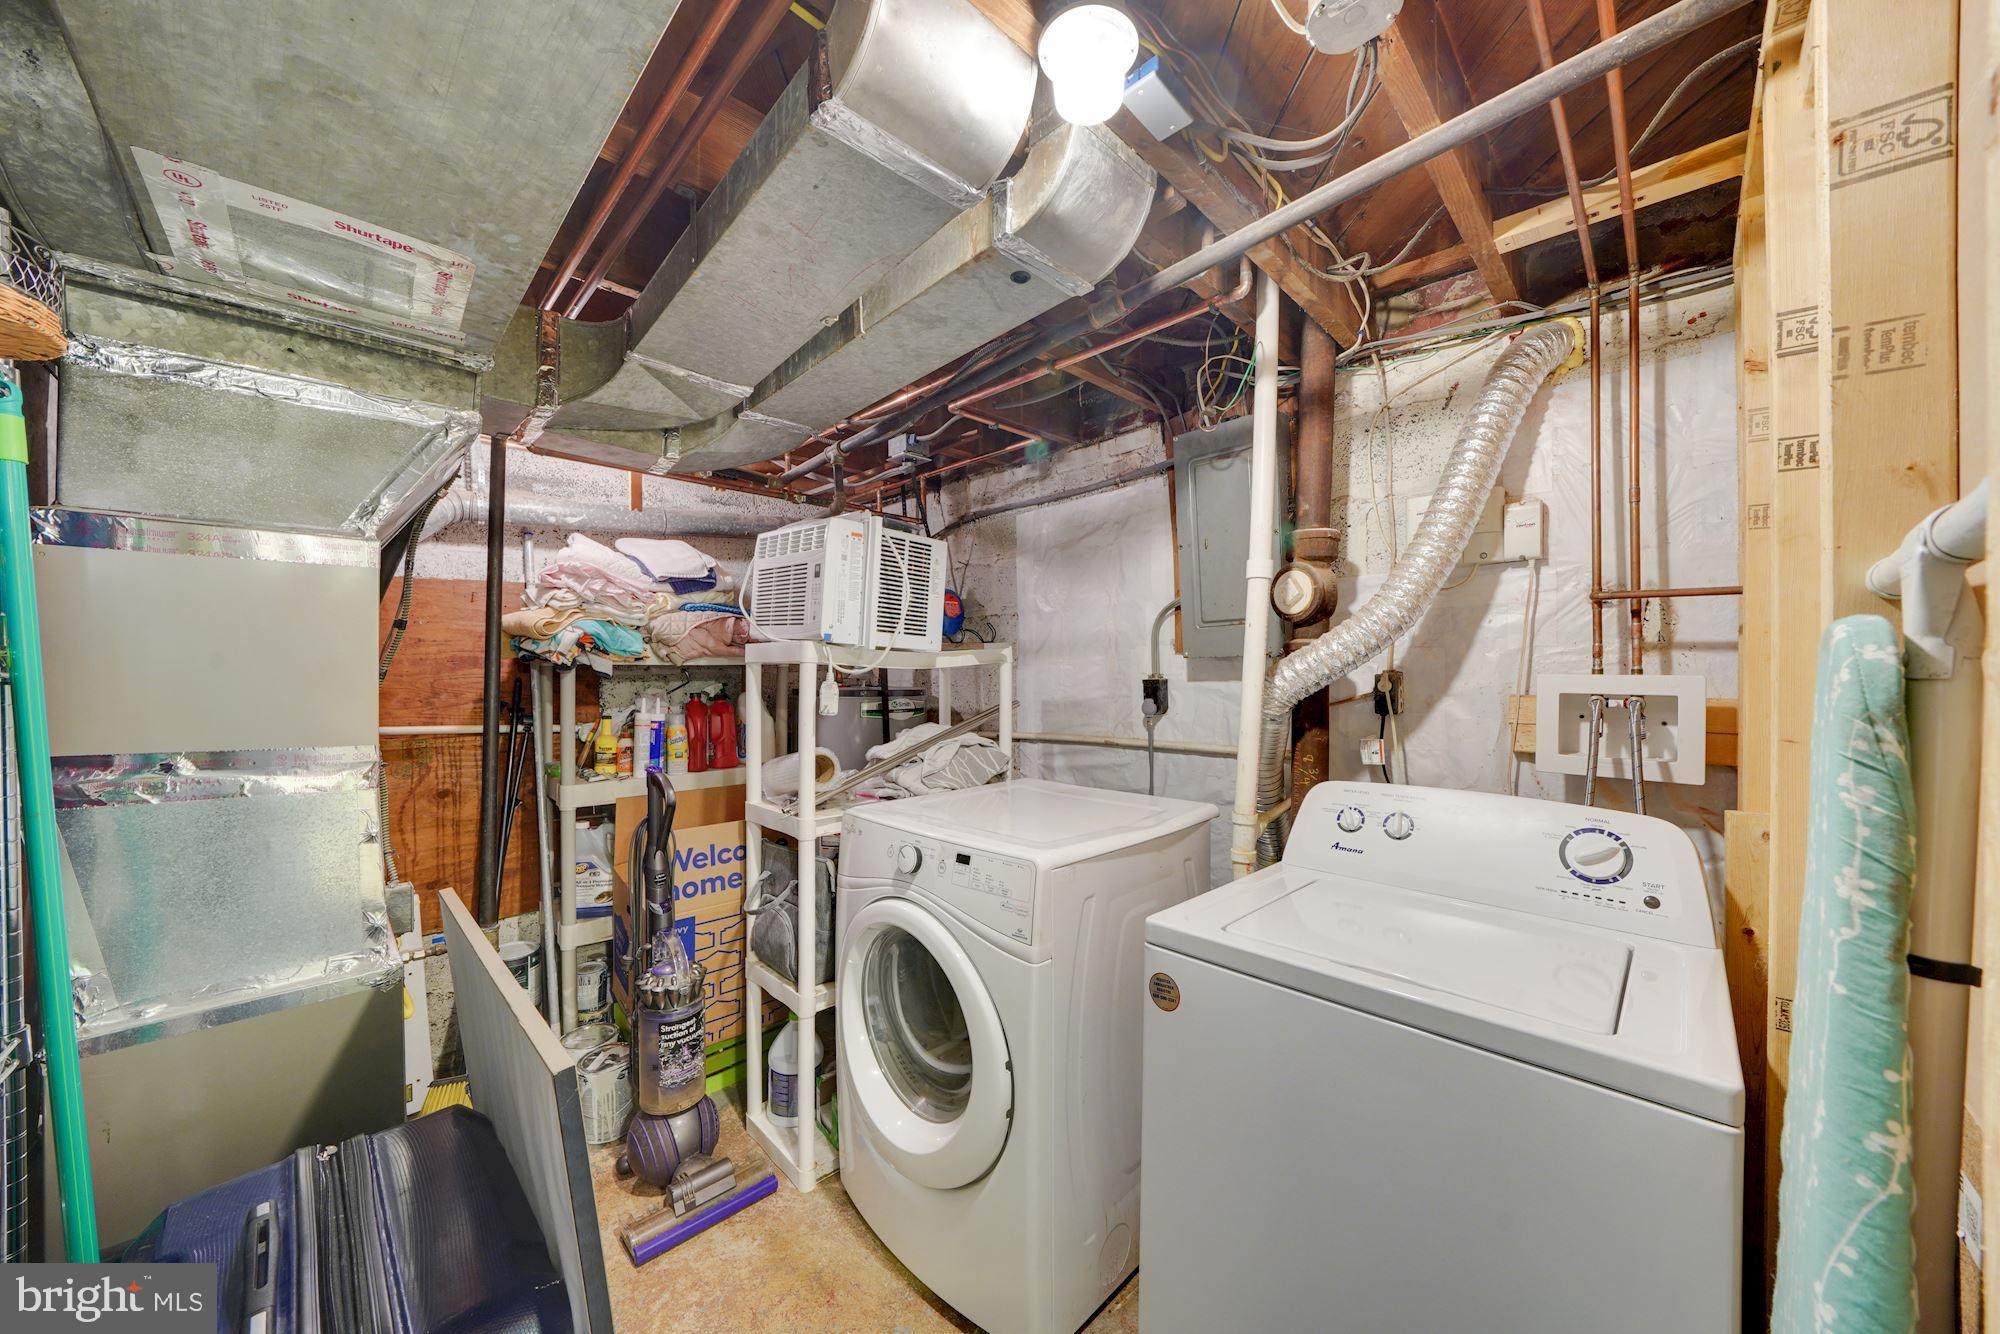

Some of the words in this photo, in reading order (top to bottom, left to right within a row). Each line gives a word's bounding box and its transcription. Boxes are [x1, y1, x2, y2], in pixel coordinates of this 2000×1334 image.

[1879, 118, 1896, 155] FSC
[251, 194, 289, 210] LISTED
[333, 219, 416, 254] Shurtape
[1795, 319, 1806, 343] FSC
[1879, 327, 1897, 365] TemPlus
[1901, 319, 1920, 365] tembec
[1584, 817, 1612, 826] NORMAL
[1330, 841, 1365, 855] Amana
[1641, 881, 1666, 891] START
[660, 1017, 697, 1033] Strongest
[689, 1023, 697, 1034] of
